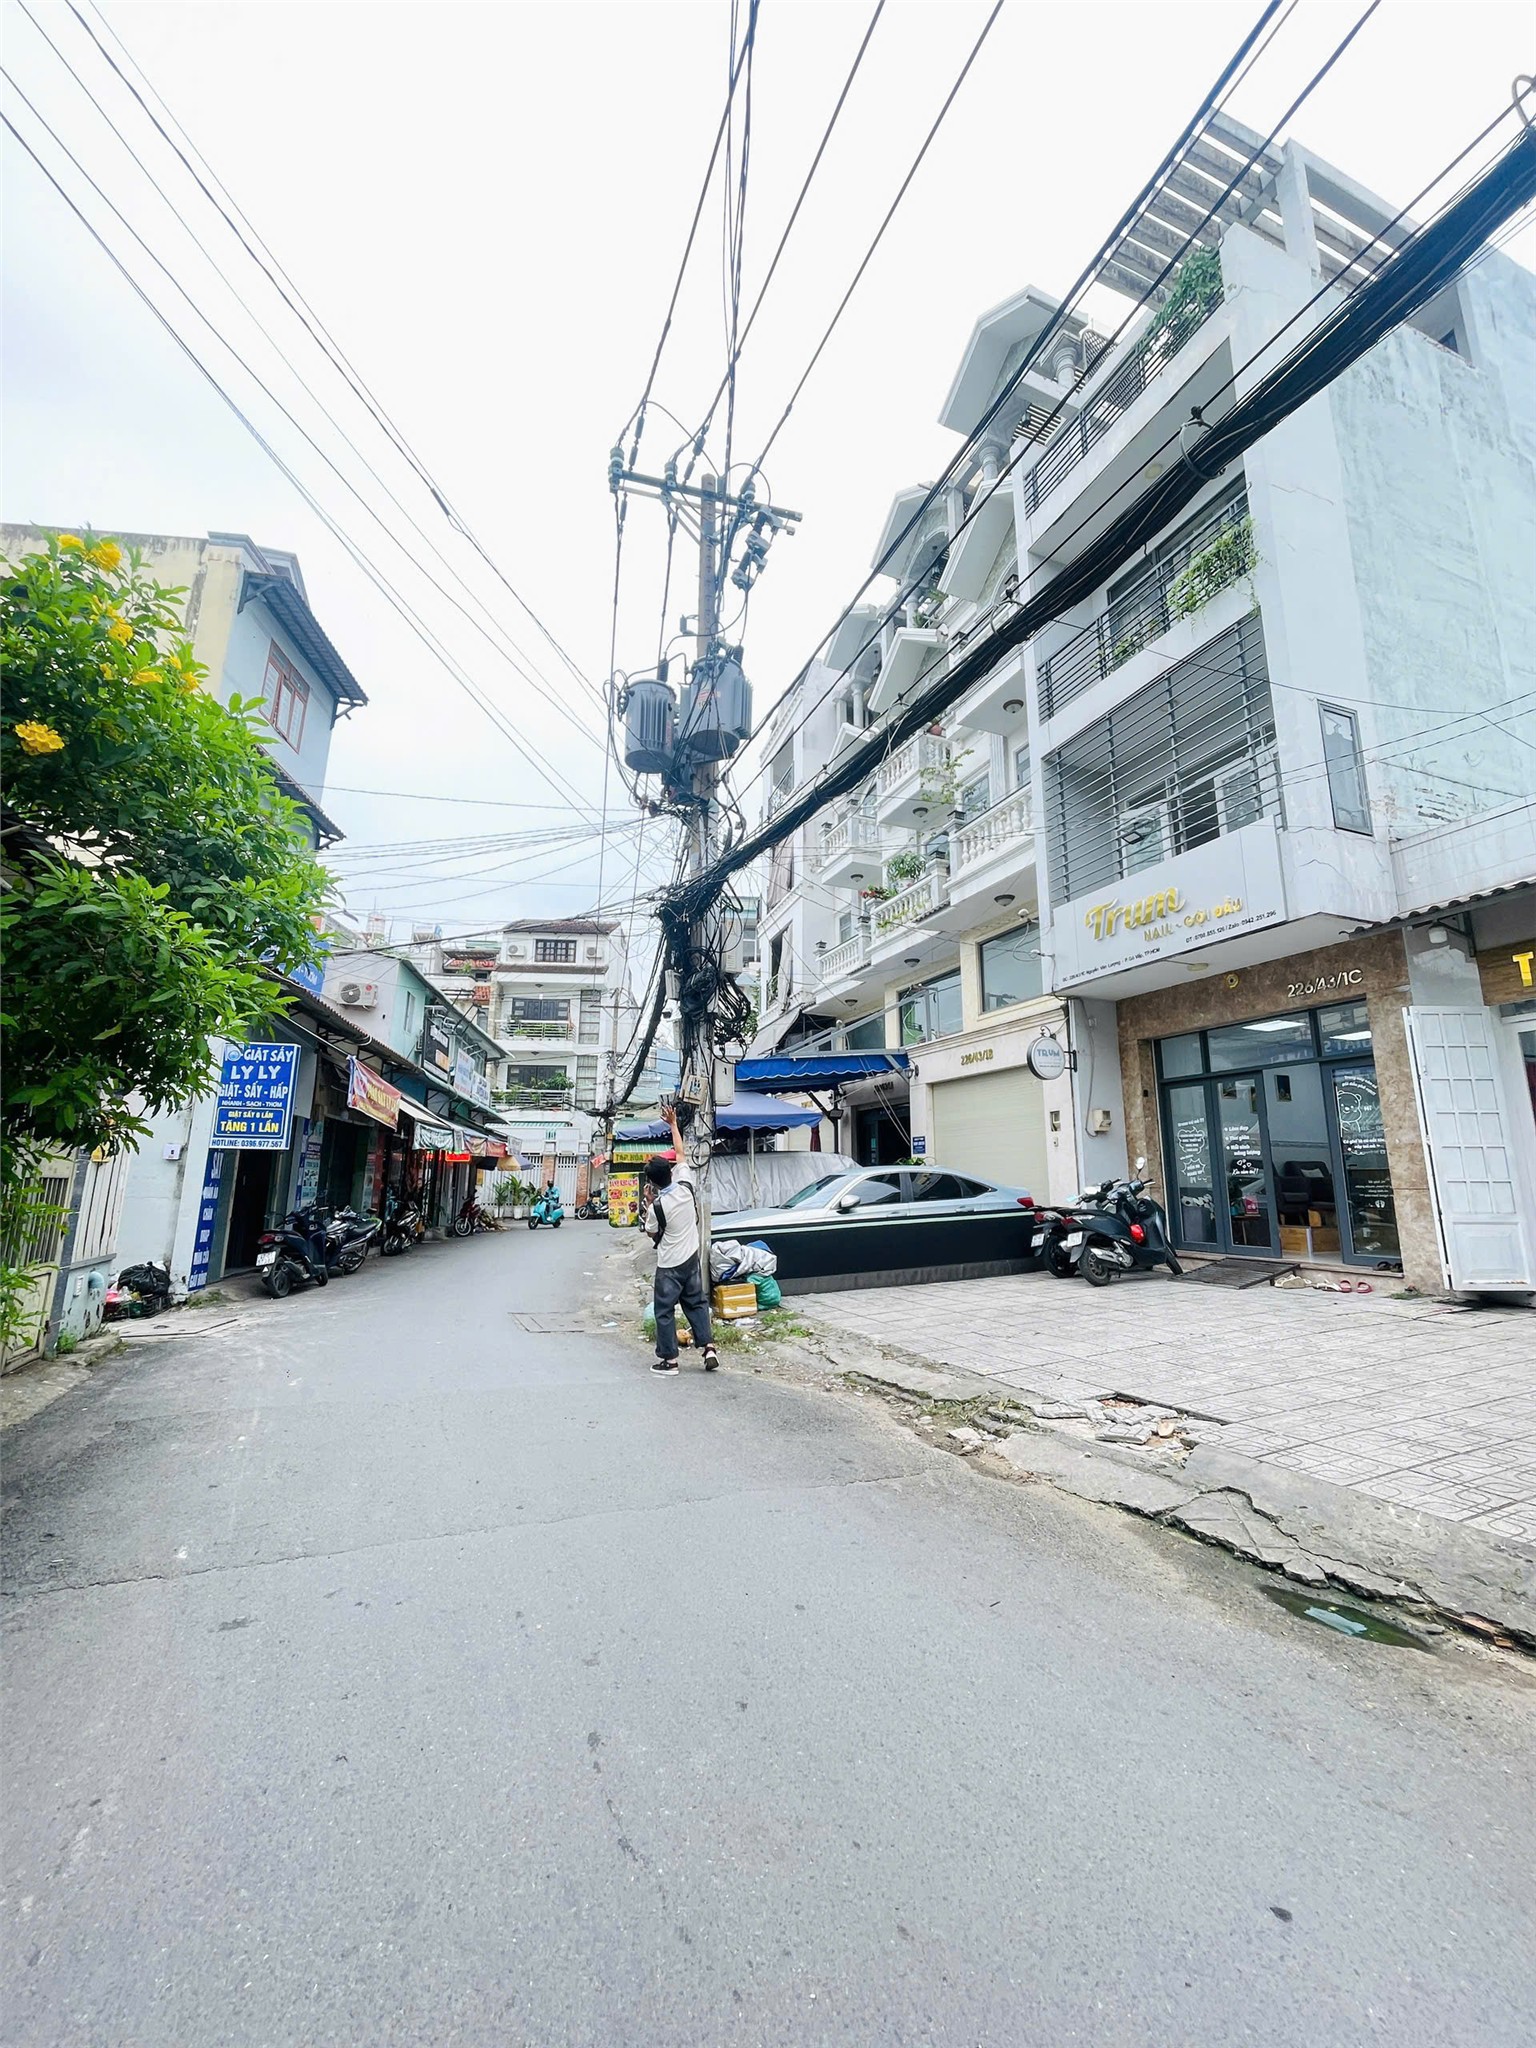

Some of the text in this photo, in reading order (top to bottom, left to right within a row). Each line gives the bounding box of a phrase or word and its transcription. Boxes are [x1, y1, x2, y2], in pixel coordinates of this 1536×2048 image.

[1085, 886, 1185, 941] Trum
[1144, 923, 1175, 941] NAIL
[1287, 968, 1363, 998] 226/43/1C
[244, 1046, 293, 1063] GIẶT SẤY
[230, 1065, 281, 1079] LY LY
[244, 1080, 262, 1098] SẤY
[269, 1081, 288, 1099] HẤP
[228, 1110, 242, 1119] GIẶT
[243, 1109, 255, 1118] SẤY
[220, 1118, 247, 1134] TẶNG
[250, 1122, 256, 1132] 1
[212, 1139, 240, 1148] HOTLINE:
